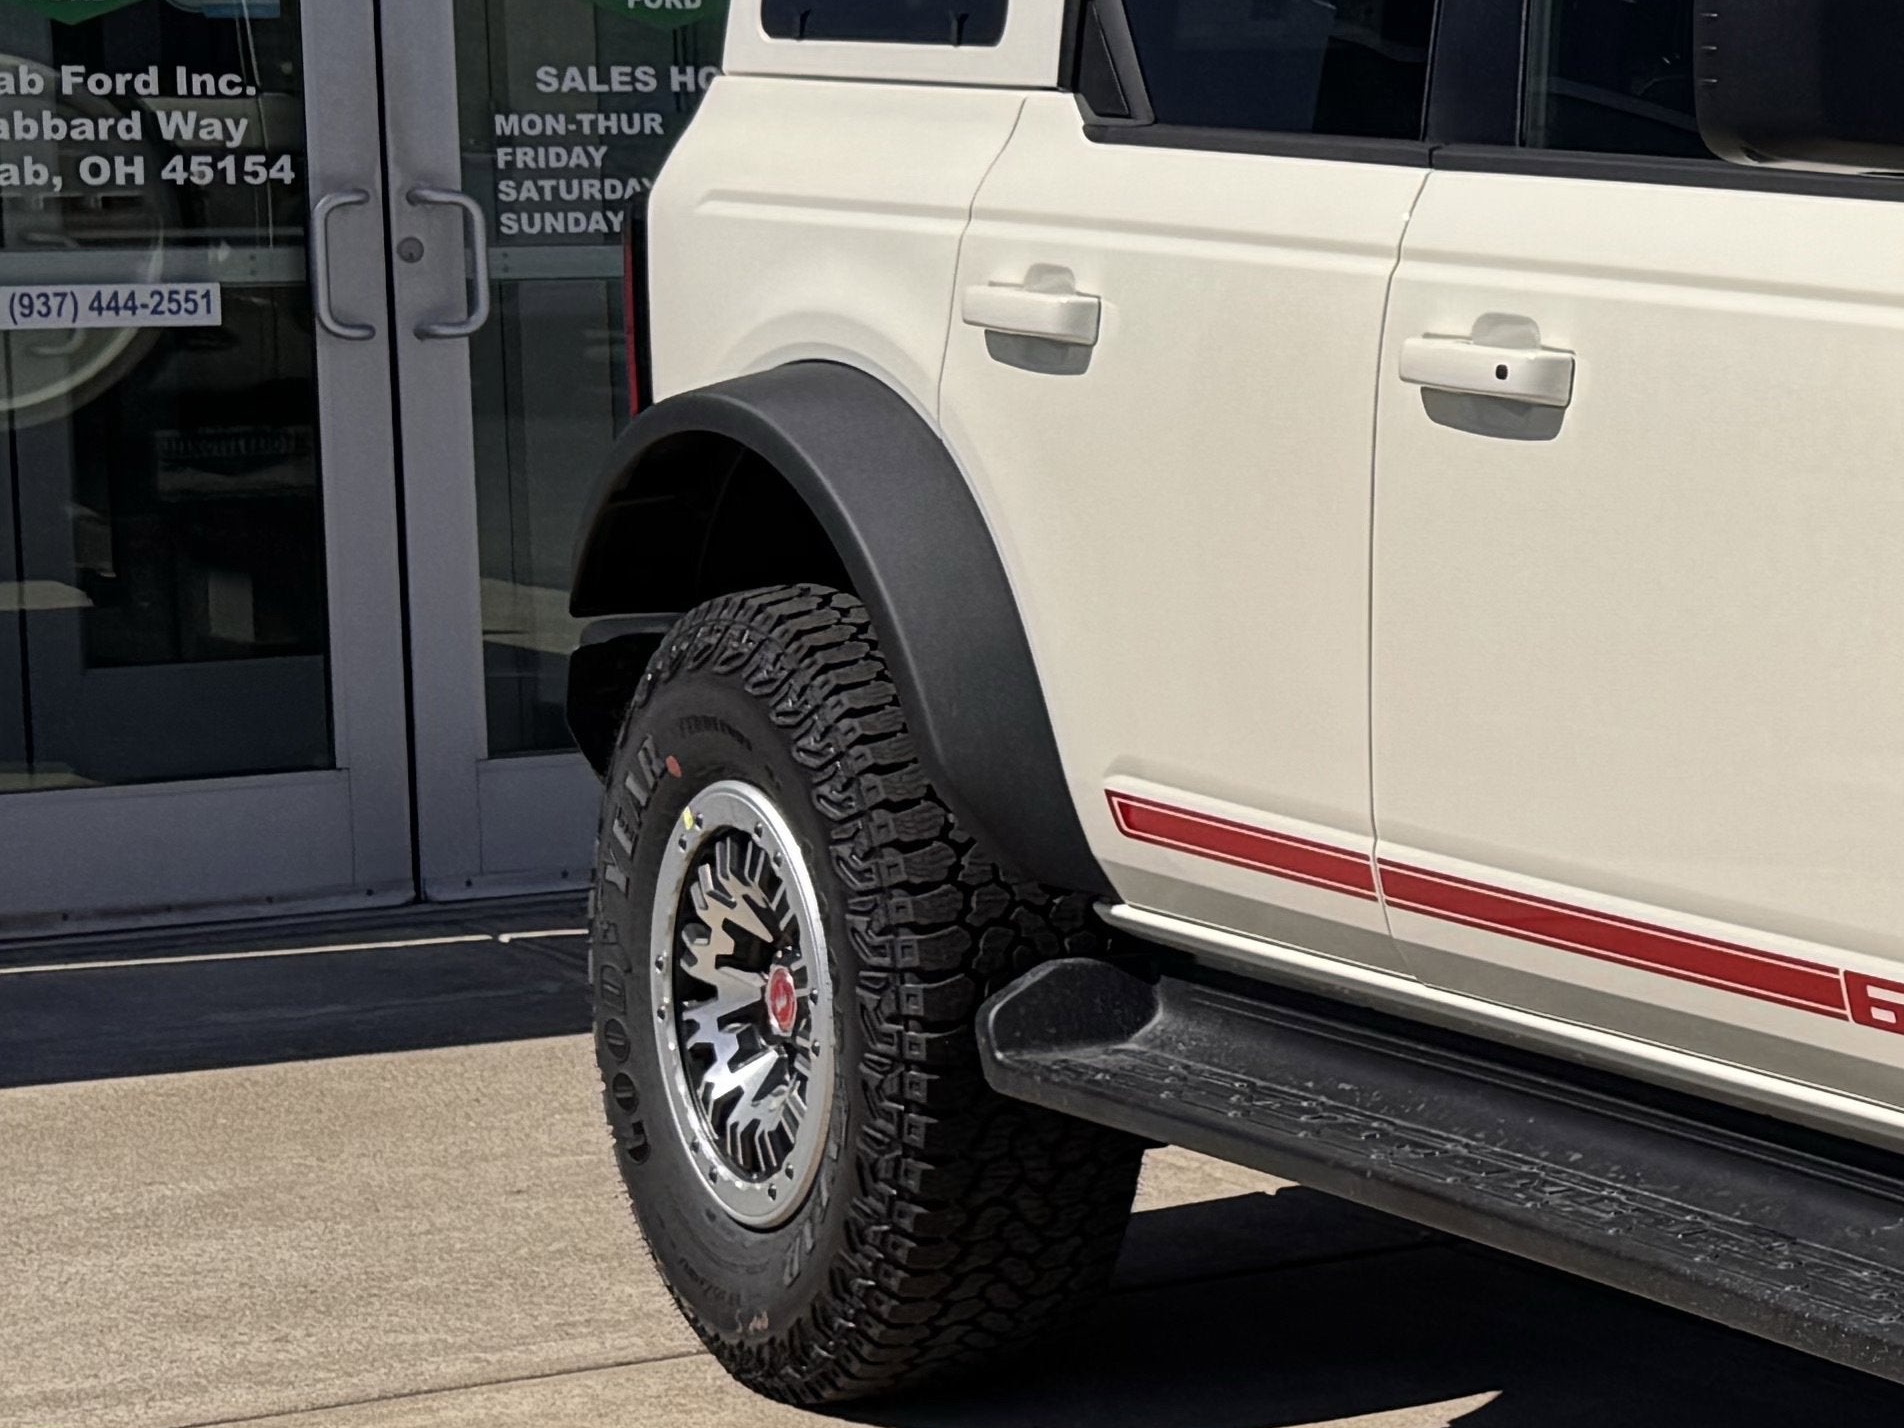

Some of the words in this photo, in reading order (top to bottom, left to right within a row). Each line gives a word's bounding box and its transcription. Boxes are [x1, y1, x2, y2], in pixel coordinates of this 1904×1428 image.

[61, 64, 159, 97] Ford
[175, 66, 257, 96] Inc.
[535, 65, 658, 93] SALES
[156, 110, 249, 147] Way
[494, 112, 664, 135] MON-THUR
[79, 155, 145, 186] OH
[161, 154, 295, 186] 45154
[497, 145, 608, 169] FRIDAY
[500, 210, 625, 235] SUNDAY
[8, 290, 79, 322] (937)
[88, 288, 214, 318] 444-2551
